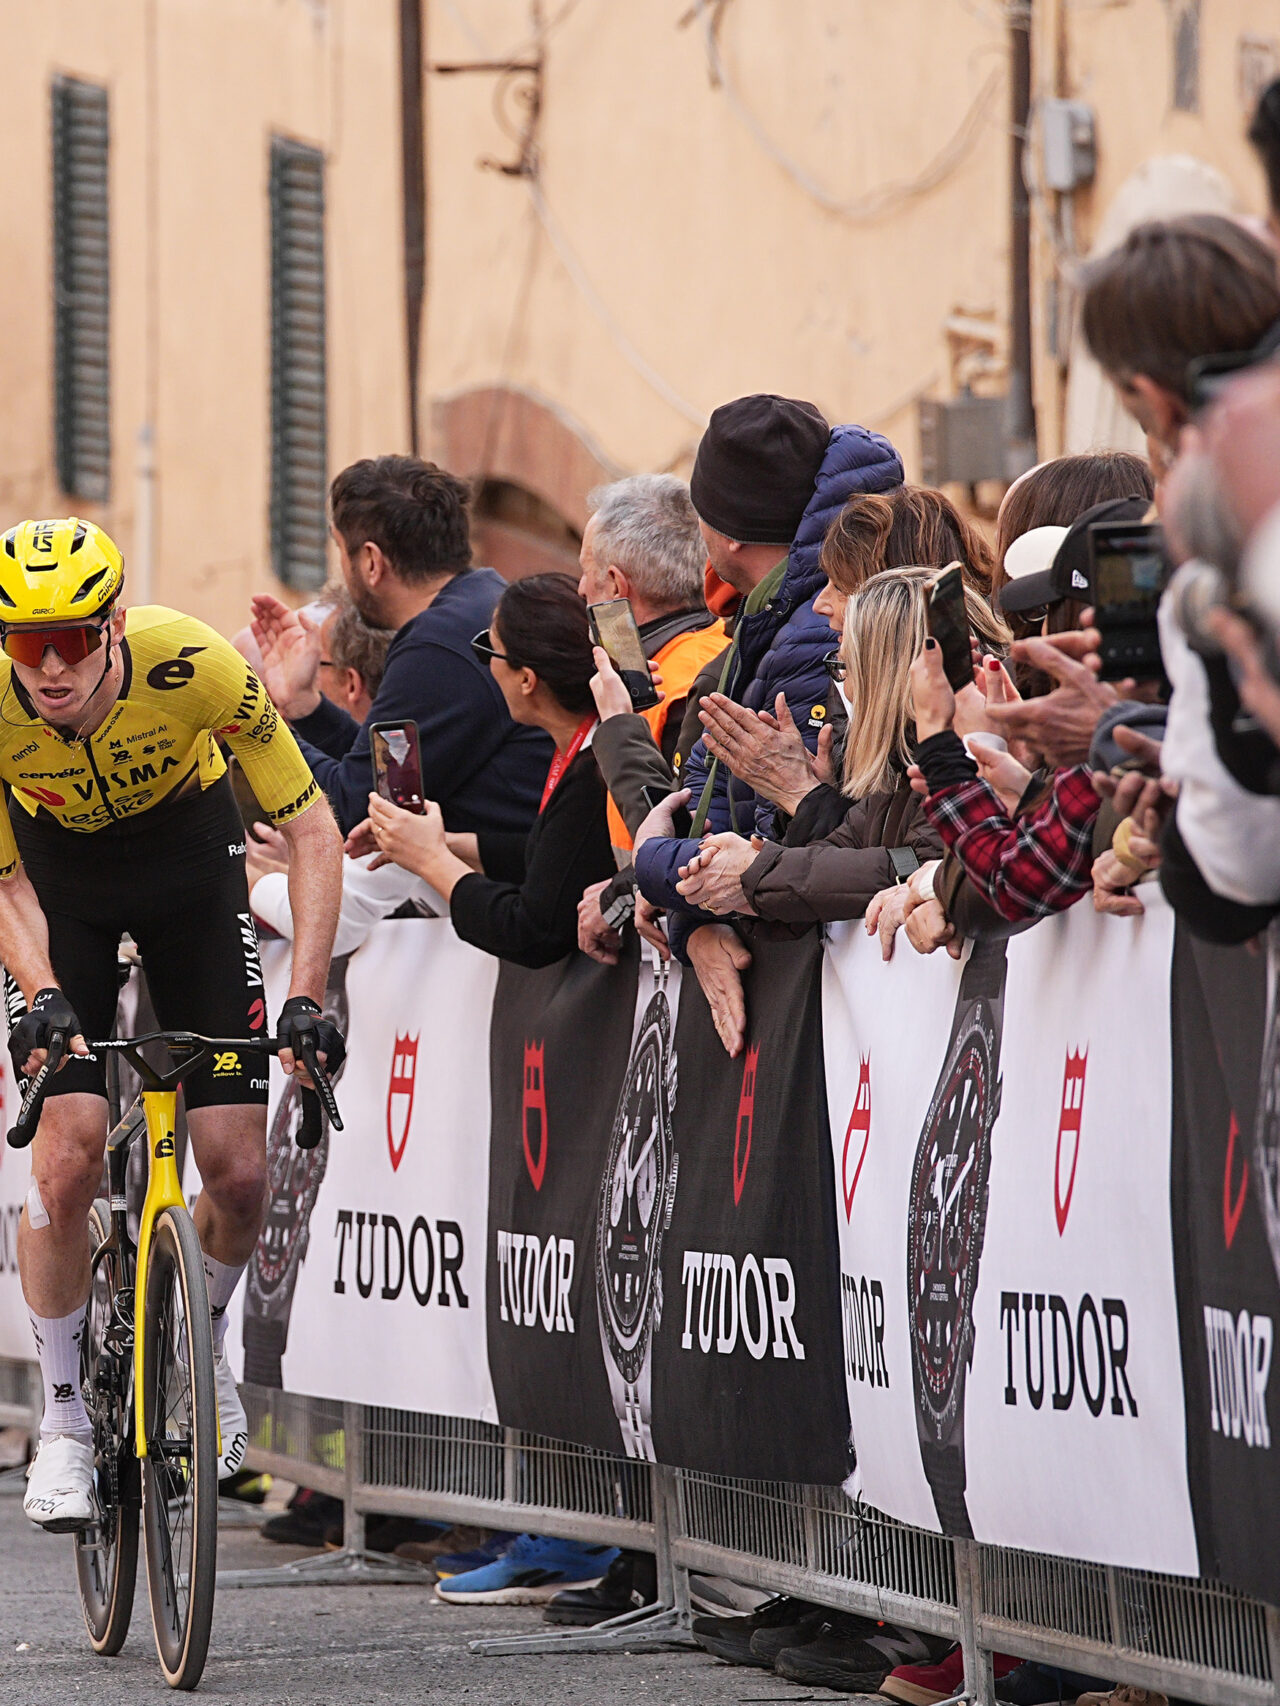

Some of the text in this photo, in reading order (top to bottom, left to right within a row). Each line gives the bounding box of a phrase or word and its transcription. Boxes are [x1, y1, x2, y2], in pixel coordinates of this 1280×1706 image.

[12, 741, 40, 762] nimbl
[126, 728, 156, 744] Mistral
[19, 768, 86, 779] cervélo
[73, 756, 181, 801] VISMA
[237, 913, 262, 987] VISMA
[22, 1065, 49, 1114] SRAM
[250, 1078, 268, 1090] nim
[334, 1210, 469, 1309] TUDOR
[497, 1229, 575, 1334] TUDOR
[681, 1250, 806, 1361] TUDOR
[1000, 1291, 1138, 1418] TUDOR
[1204, 1305, 1274, 1449] TUDOR
[225, 1432, 248, 1473] nim
